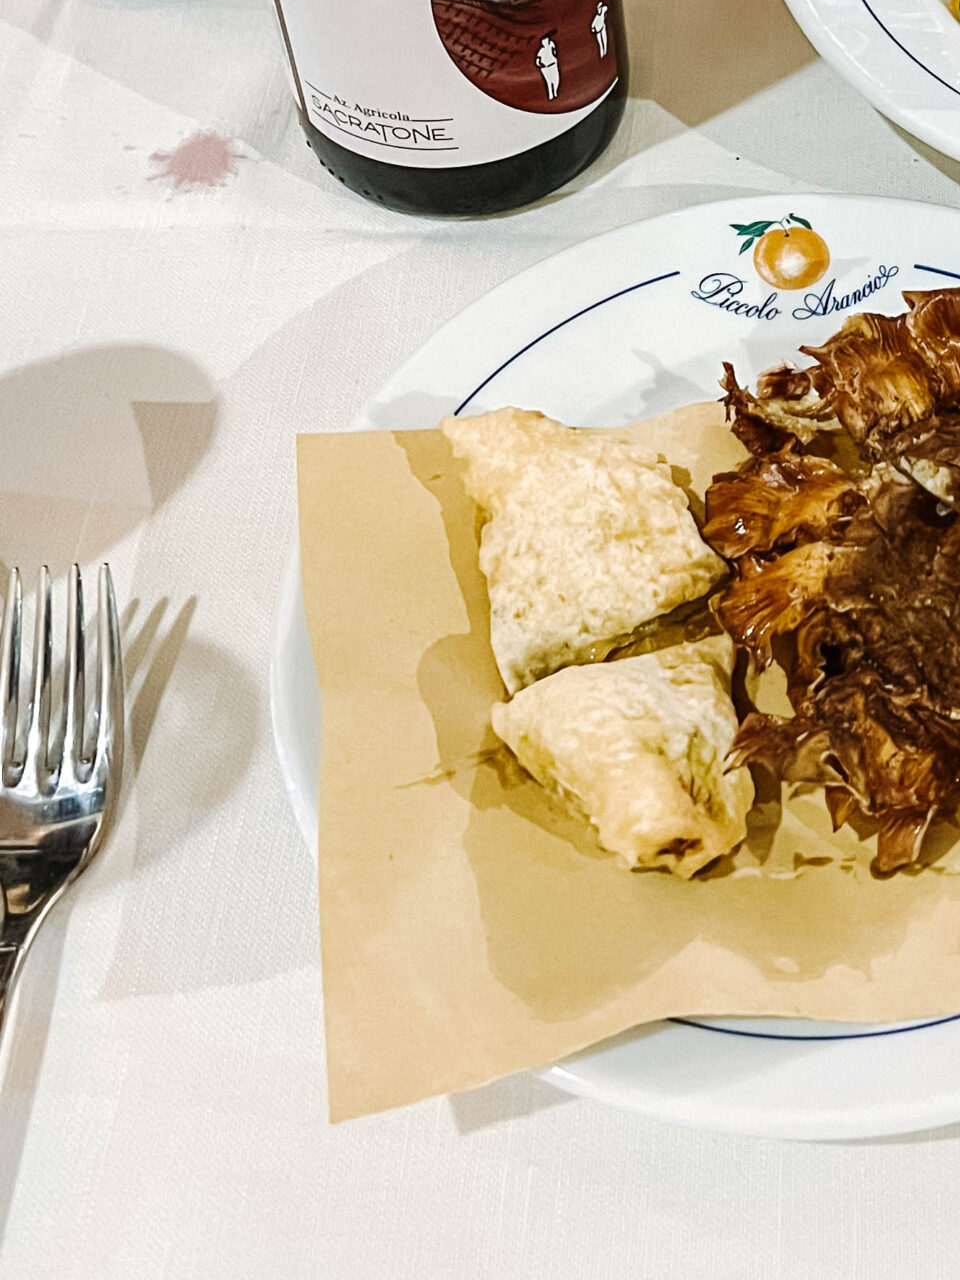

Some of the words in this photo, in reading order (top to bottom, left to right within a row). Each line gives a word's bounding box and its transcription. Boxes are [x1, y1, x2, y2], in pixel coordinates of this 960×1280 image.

[311, 94, 454, 144] SACRATONE
[354, 103, 410, 121] Agricola
[691, 272, 782, 321] Piccolo
[792, 265, 899, 320] Arancio
